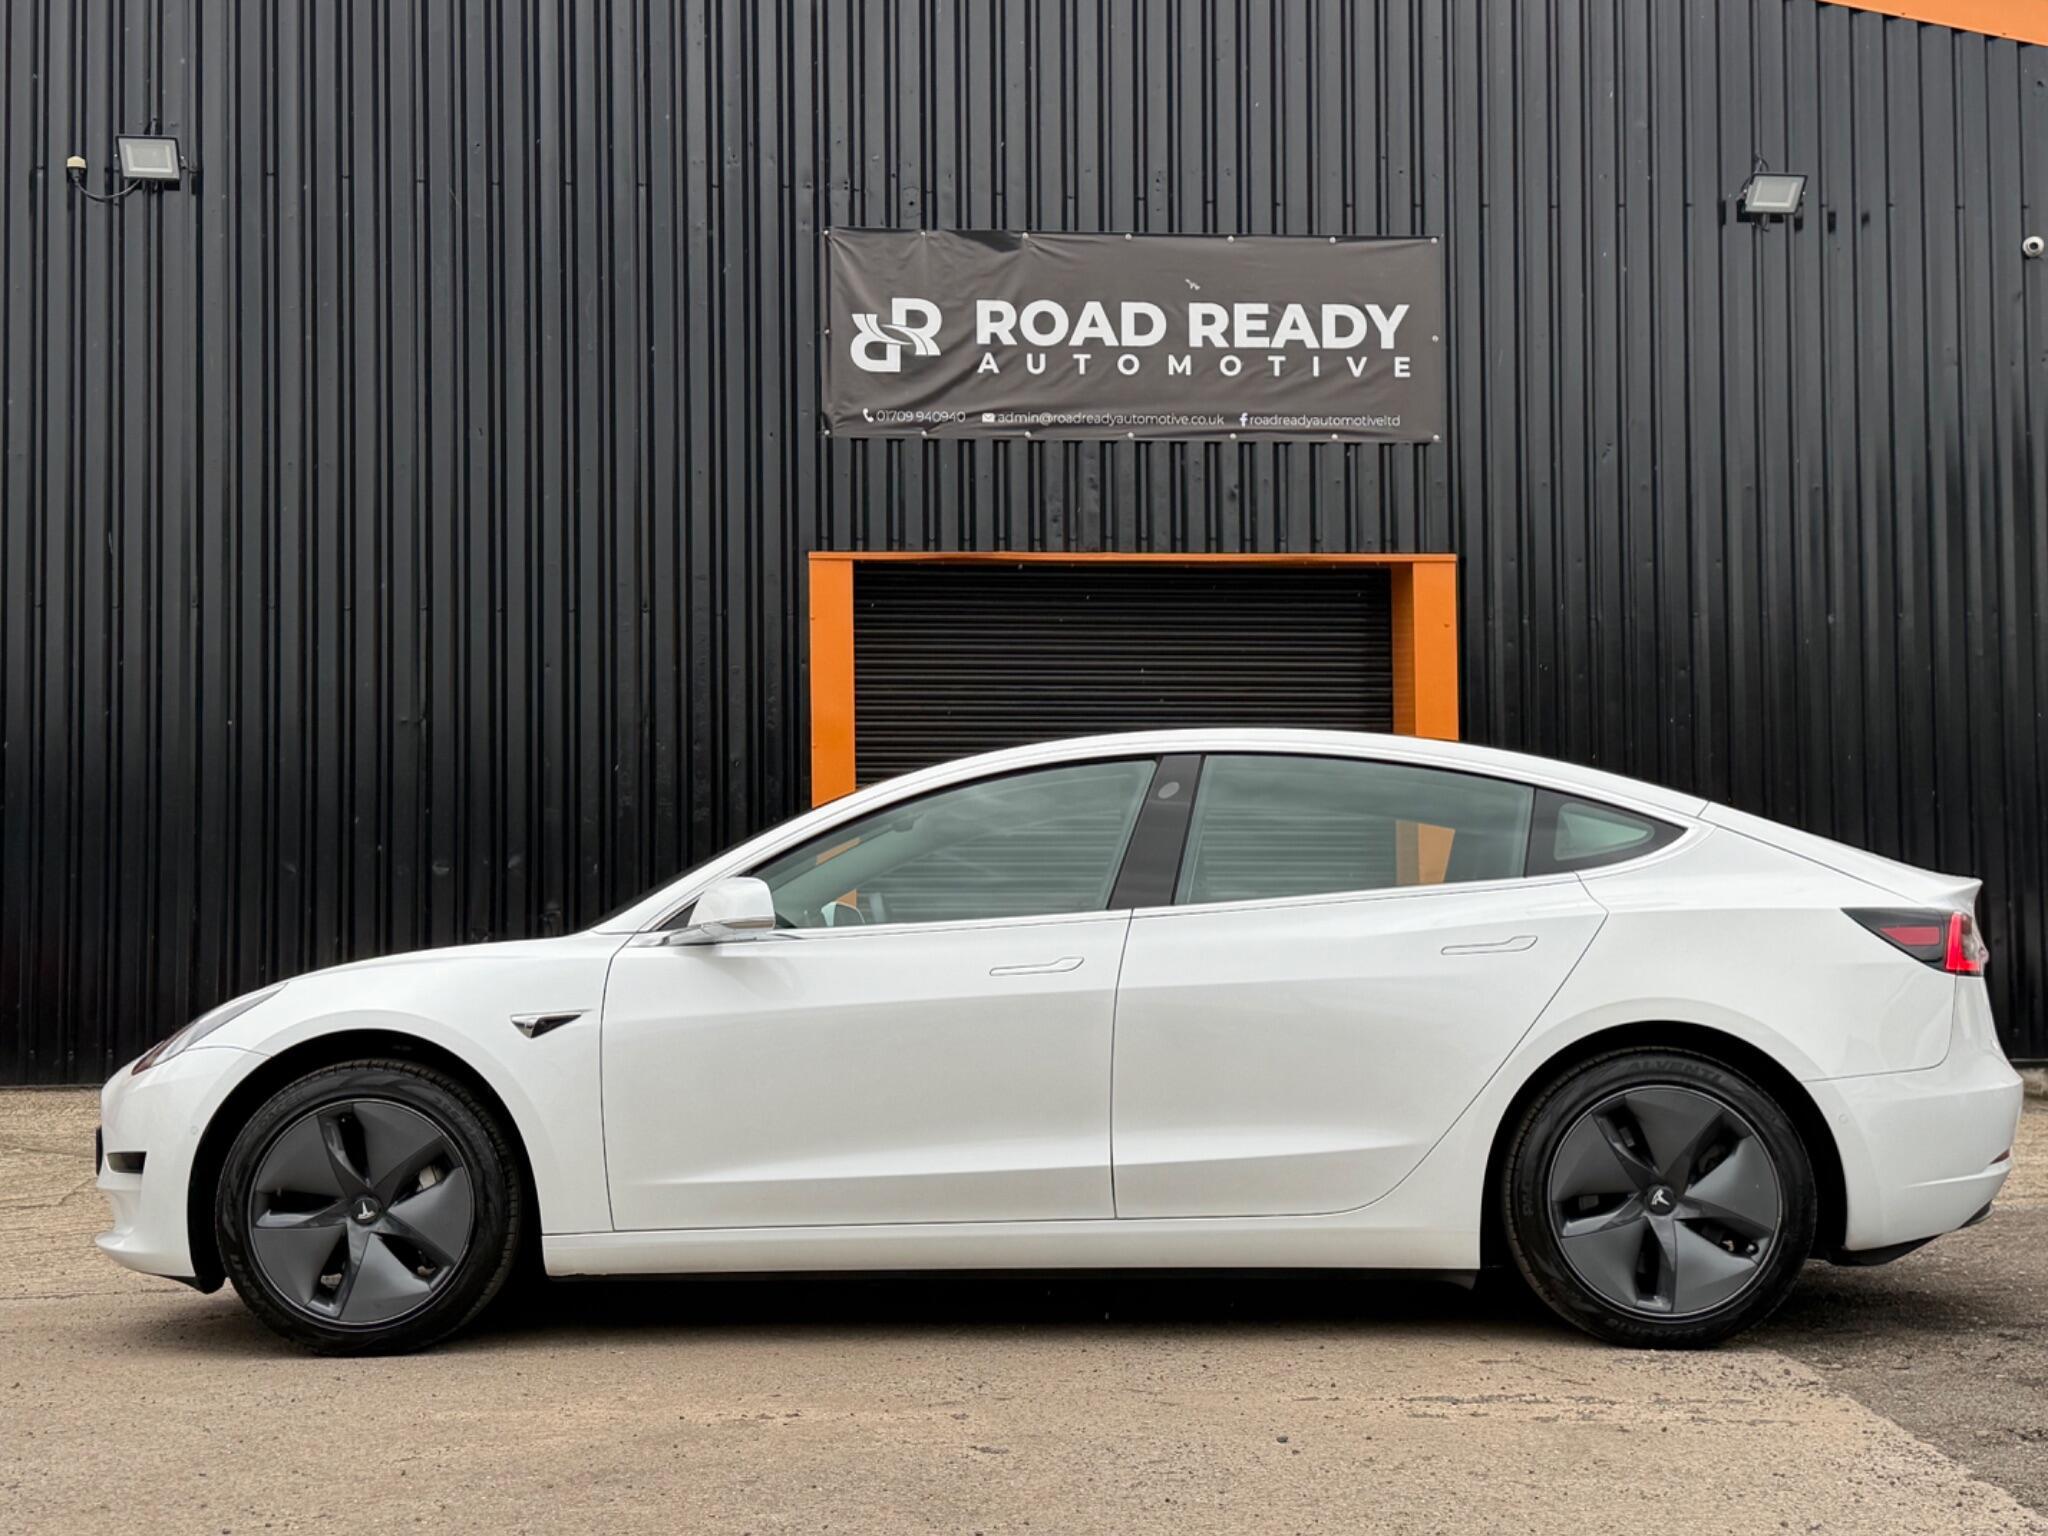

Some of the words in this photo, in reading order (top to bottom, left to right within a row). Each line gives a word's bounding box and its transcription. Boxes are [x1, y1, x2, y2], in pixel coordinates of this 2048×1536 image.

[976, 300, 1167, 347] ROAD
[1187, 303, 1410, 350] READY
[977, 352, 1412, 379] AUTOMOTIVE
[876, 410, 914, 423] 01709
[916, 411, 966, 423] 940940
[997, 411, 1225, 427] admin@roadreadyautomotive.co.uk
[1249, 413, 1401, 428] roadreadyautomotiveltd
